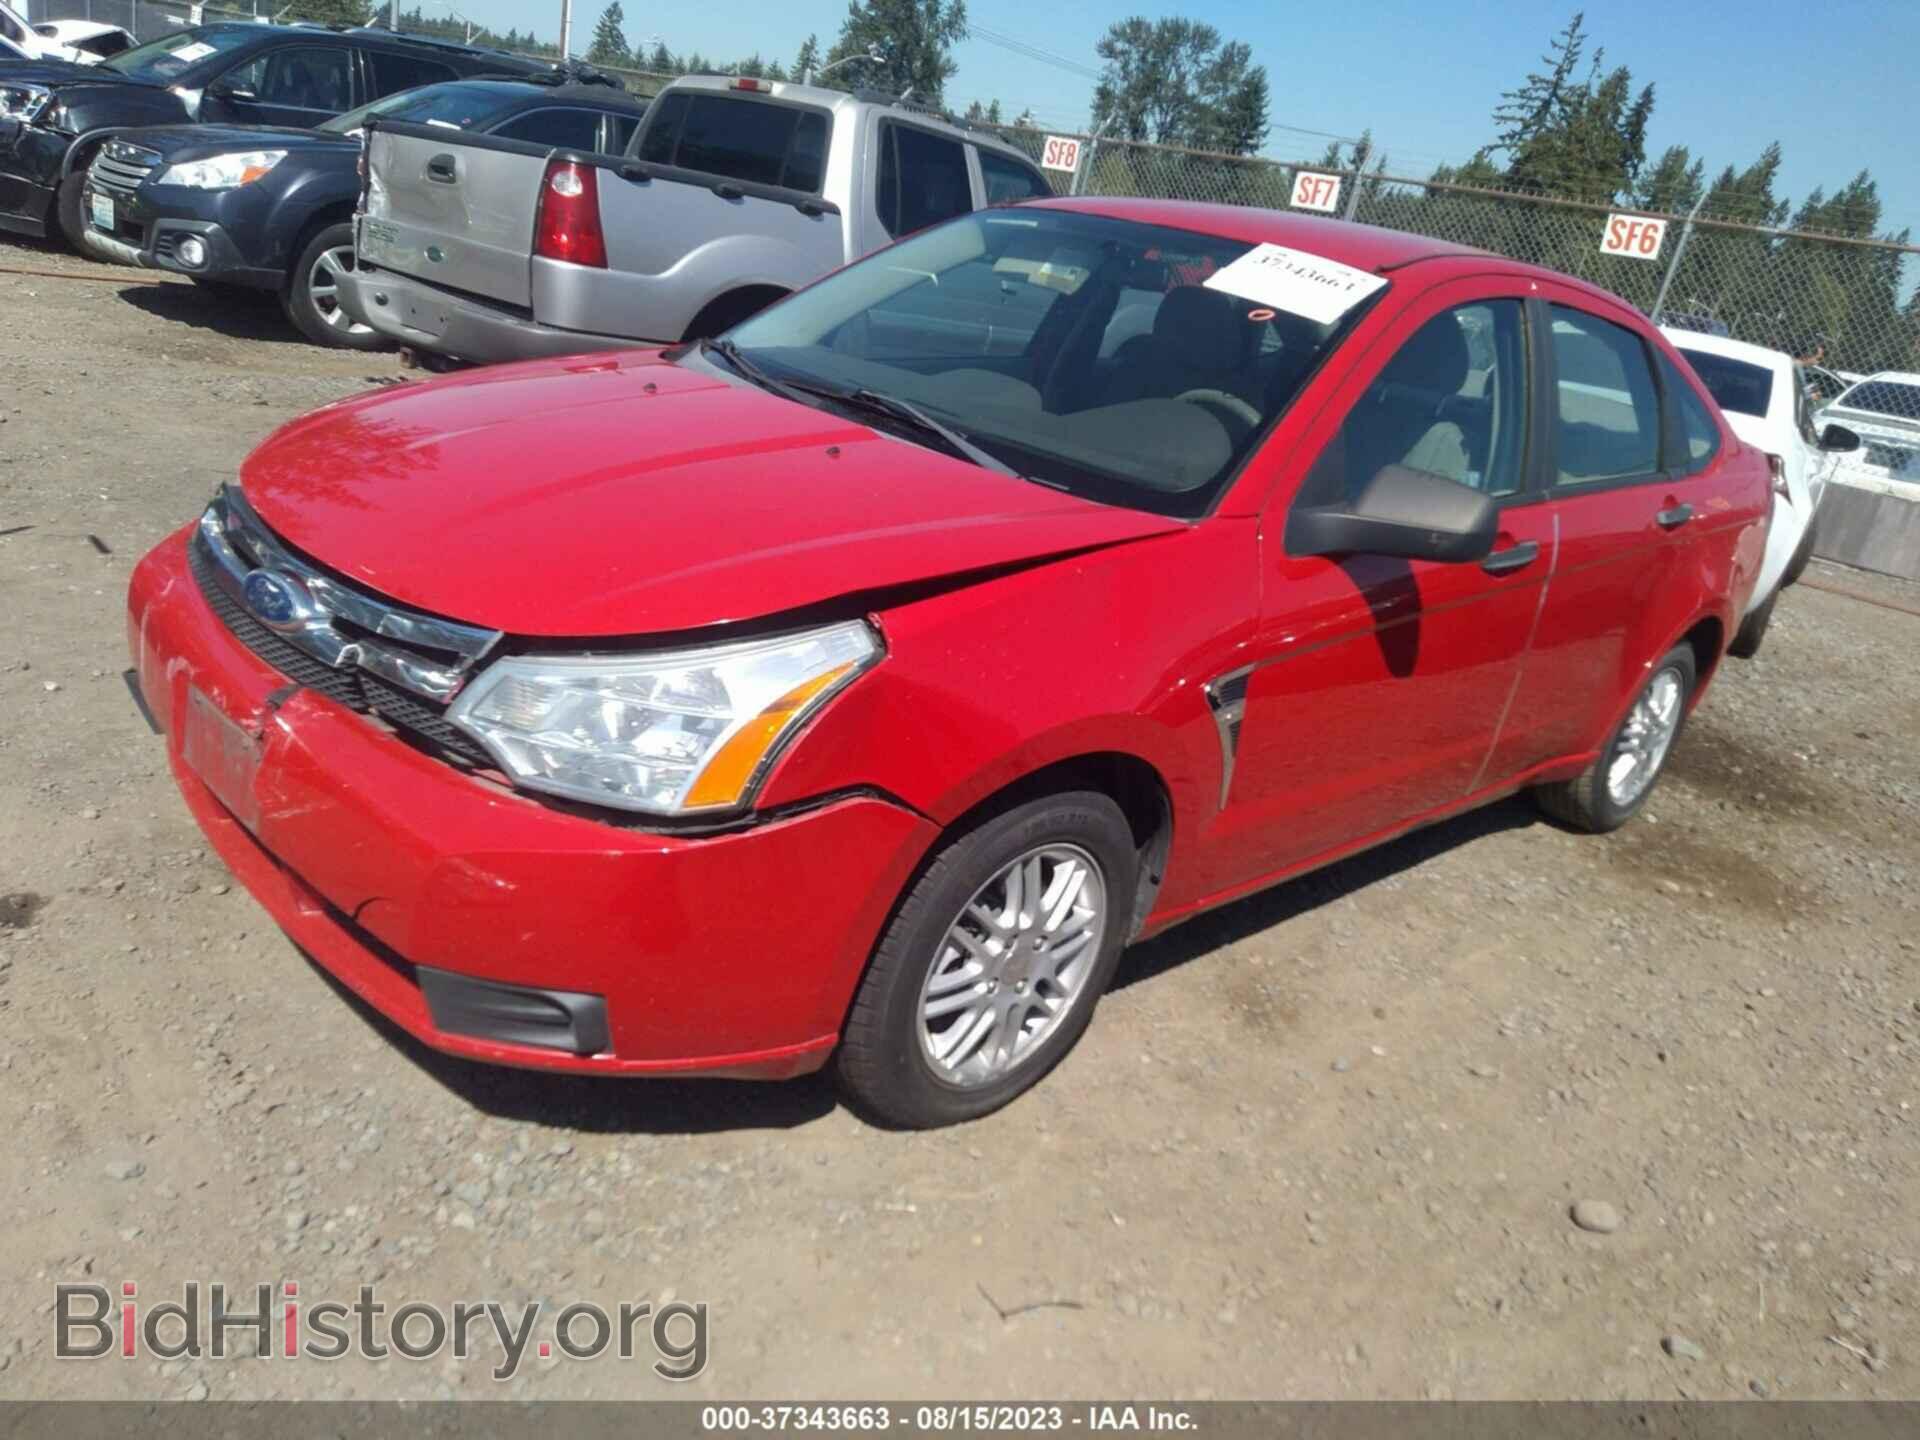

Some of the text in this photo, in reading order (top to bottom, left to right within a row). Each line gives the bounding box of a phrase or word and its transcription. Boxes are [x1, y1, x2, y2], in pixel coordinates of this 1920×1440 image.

[1047, 140, 1076, 167] SF8
[1298, 176, 1335, 206] SF7
[1607, 217, 1658, 254] SF6
